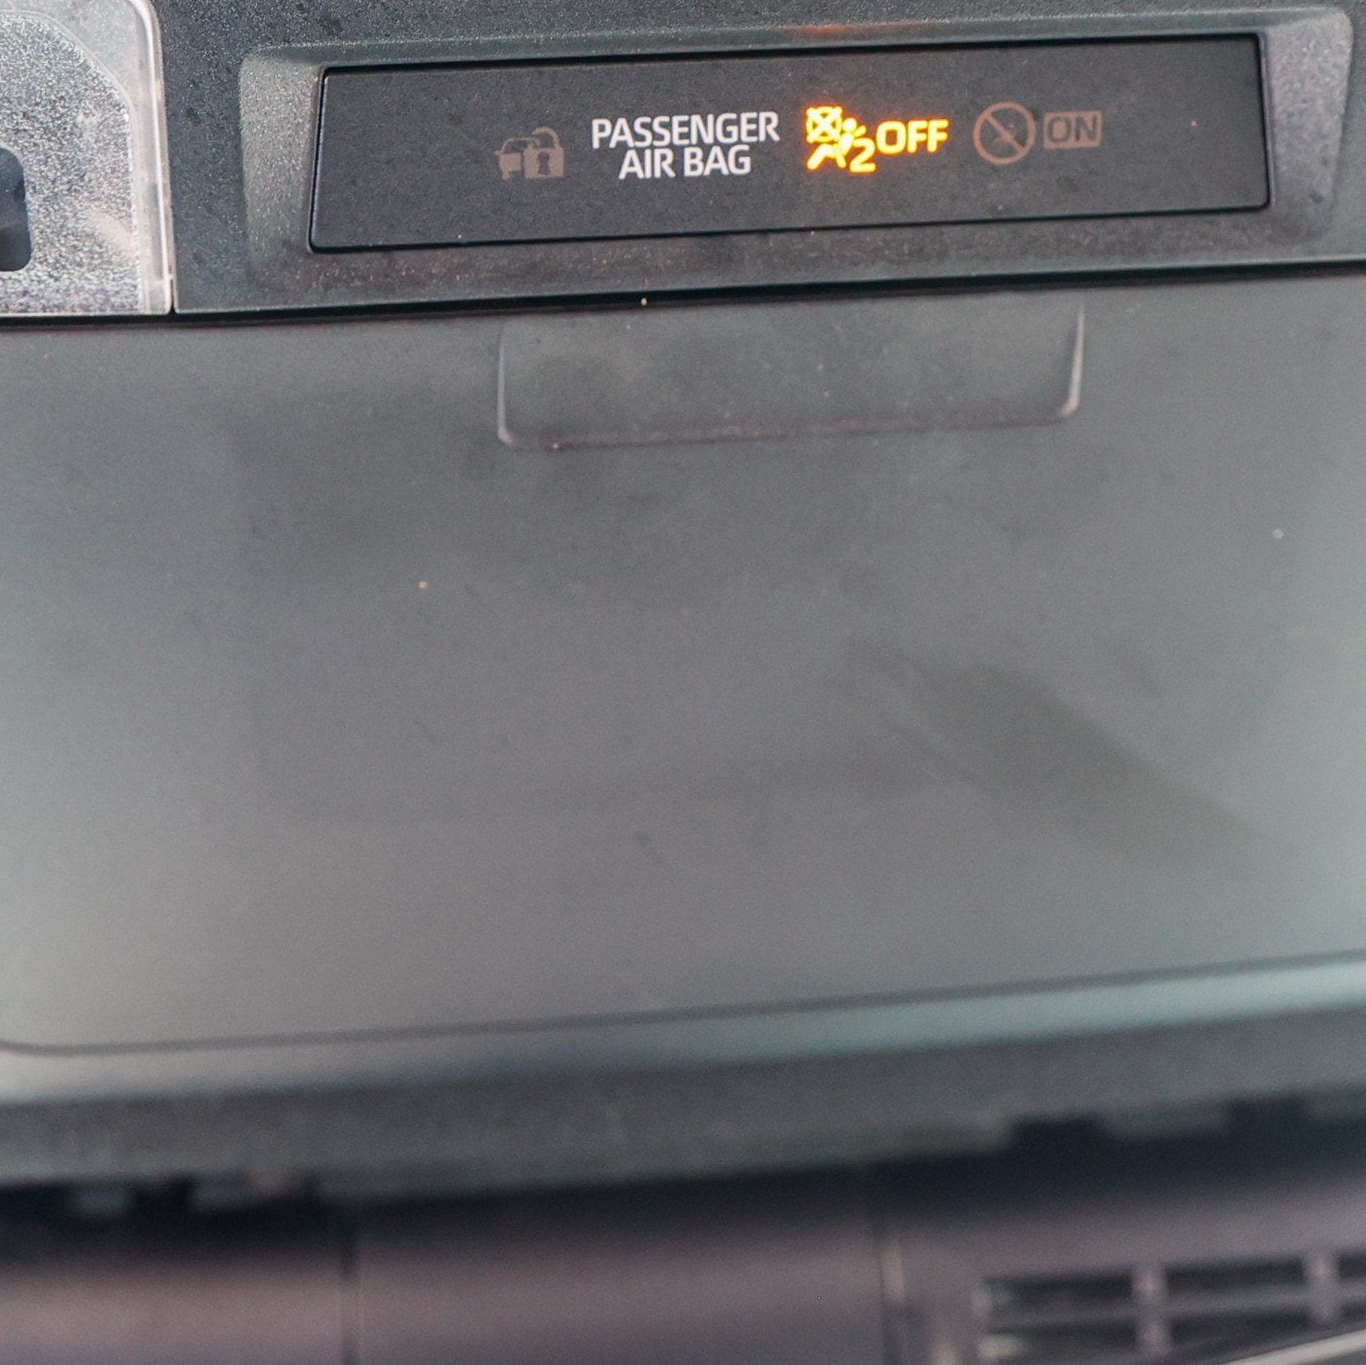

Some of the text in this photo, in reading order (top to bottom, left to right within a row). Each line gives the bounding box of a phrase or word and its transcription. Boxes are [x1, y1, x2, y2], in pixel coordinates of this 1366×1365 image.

[591, 111, 781, 150] PASSENGER
[875, 119, 949, 155] OFF
[1046, 113, 1100, 146] ON
[617, 144, 752, 181] AIR BAG
